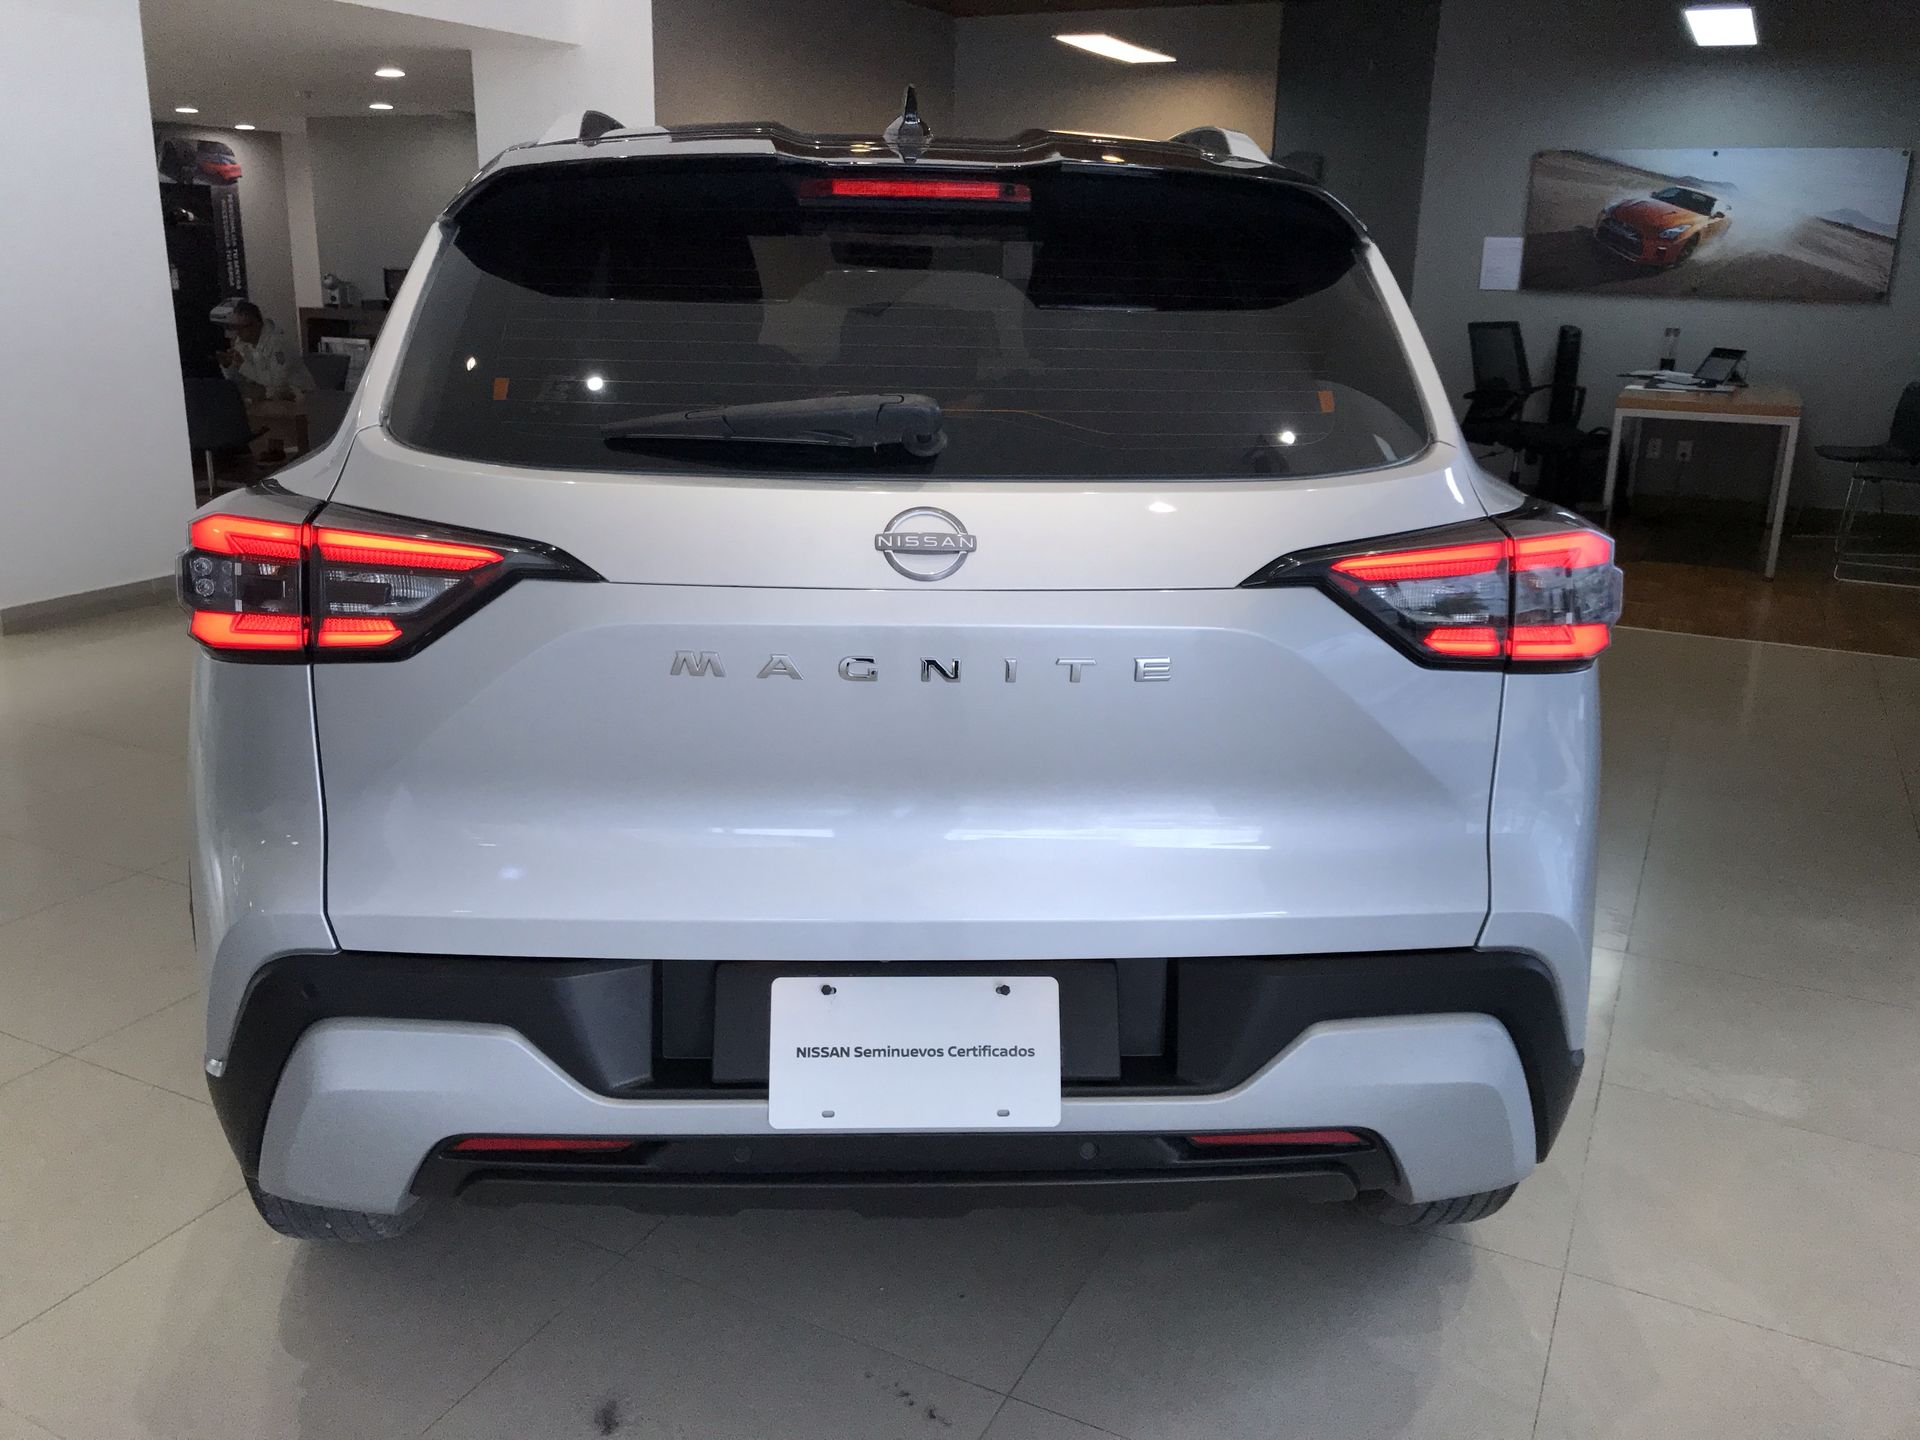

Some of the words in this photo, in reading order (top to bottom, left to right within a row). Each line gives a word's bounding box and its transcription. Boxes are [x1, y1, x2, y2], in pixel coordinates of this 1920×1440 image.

[878, 535, 974, 548] NISSAN
[669, 650, 1173, 683] MAGNITE
[796, 1046, 850, 1058] NISSAN
[854, 1045, 944, 1058] Seminuevos
[948, 1044, 1035, 1057] Certificados
